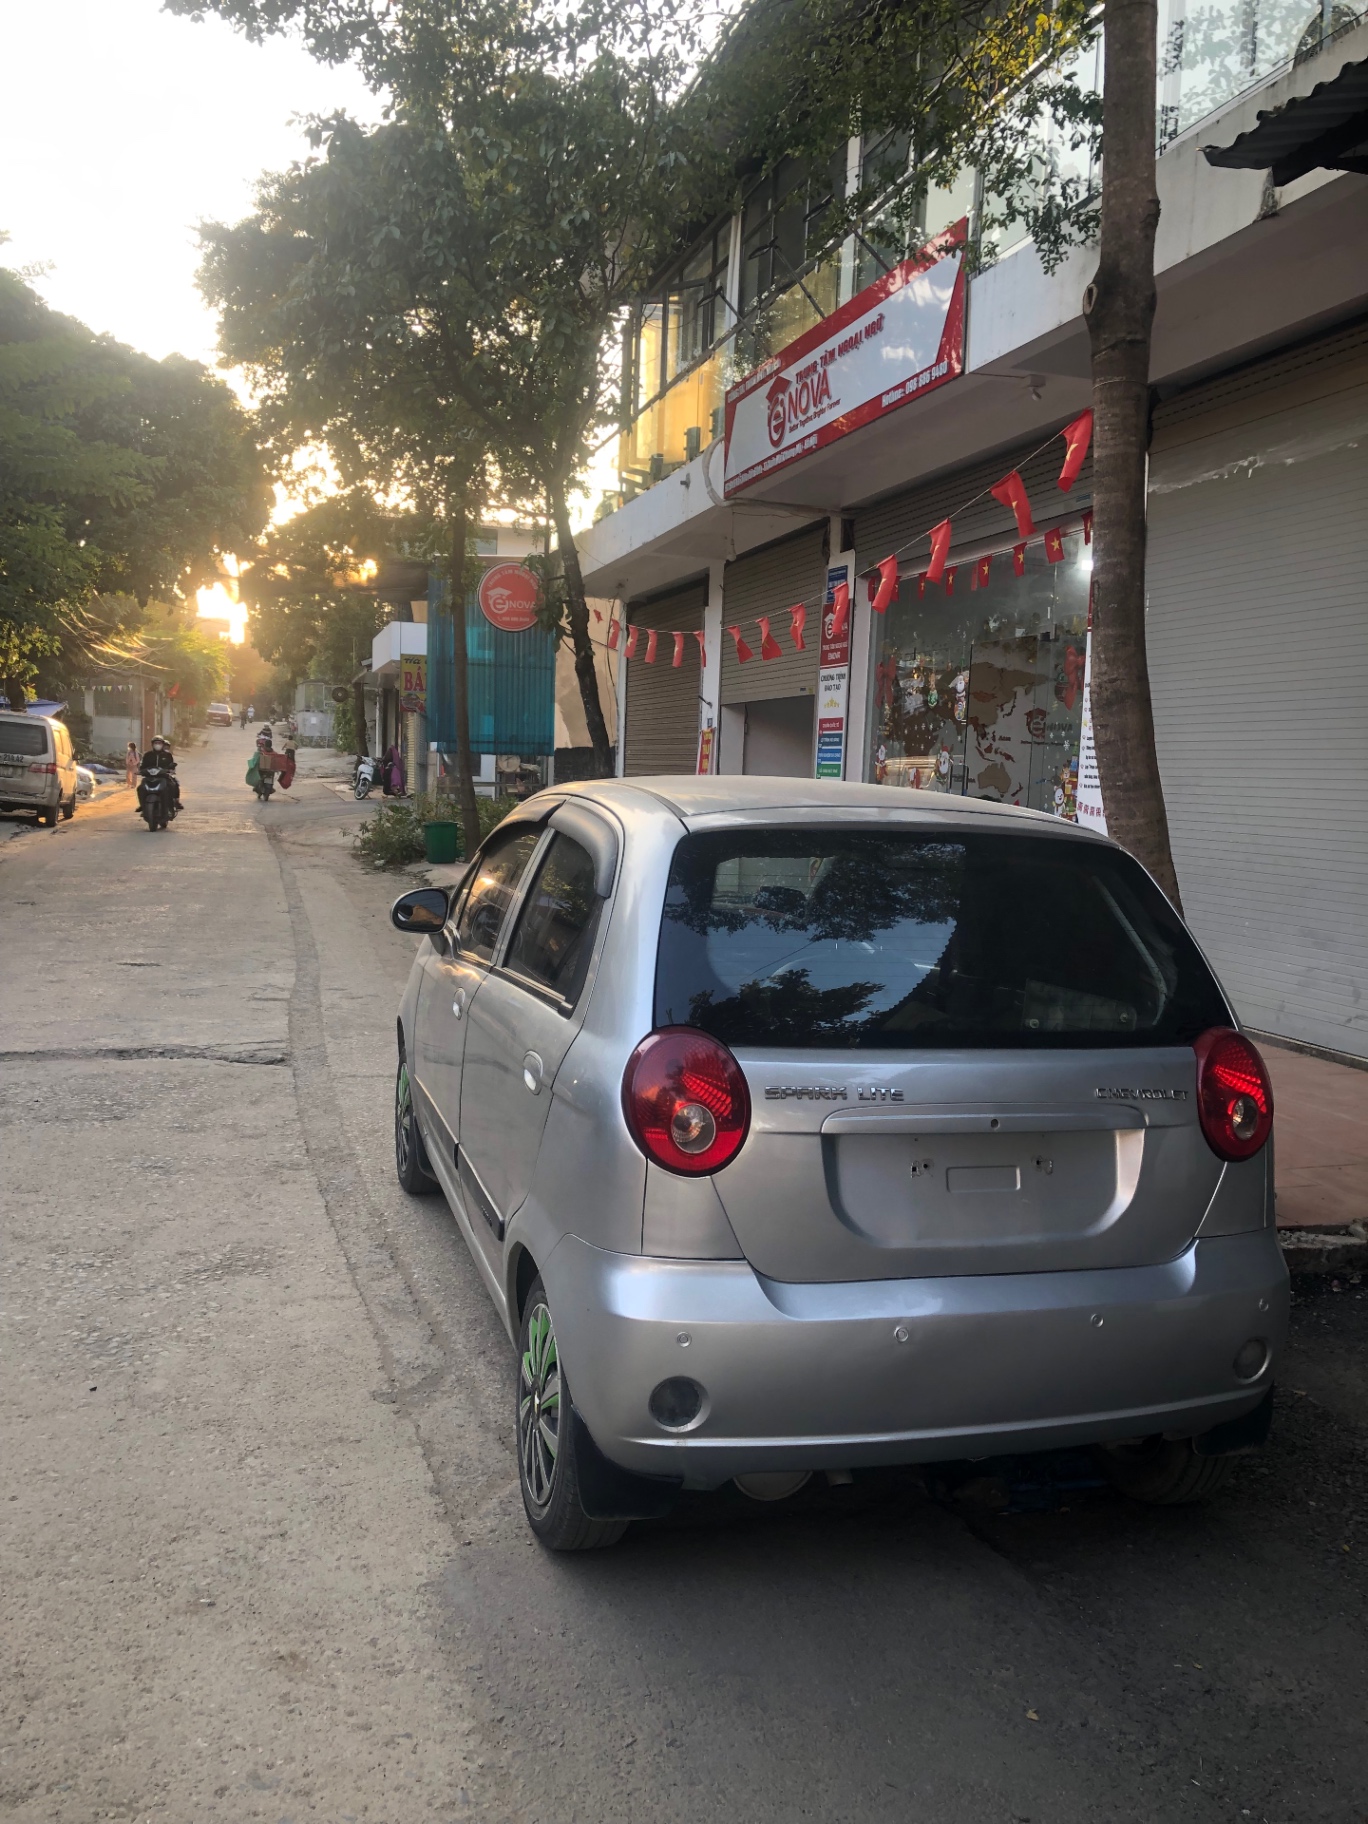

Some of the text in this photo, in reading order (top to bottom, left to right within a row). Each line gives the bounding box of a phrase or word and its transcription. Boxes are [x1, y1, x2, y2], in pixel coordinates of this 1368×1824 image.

[796, 361, 818, 384] TRUNG
[764, 1086, 904, 1101] SPARK LITE
[1095, 1088, 1188, 1101] CHEVROLET
